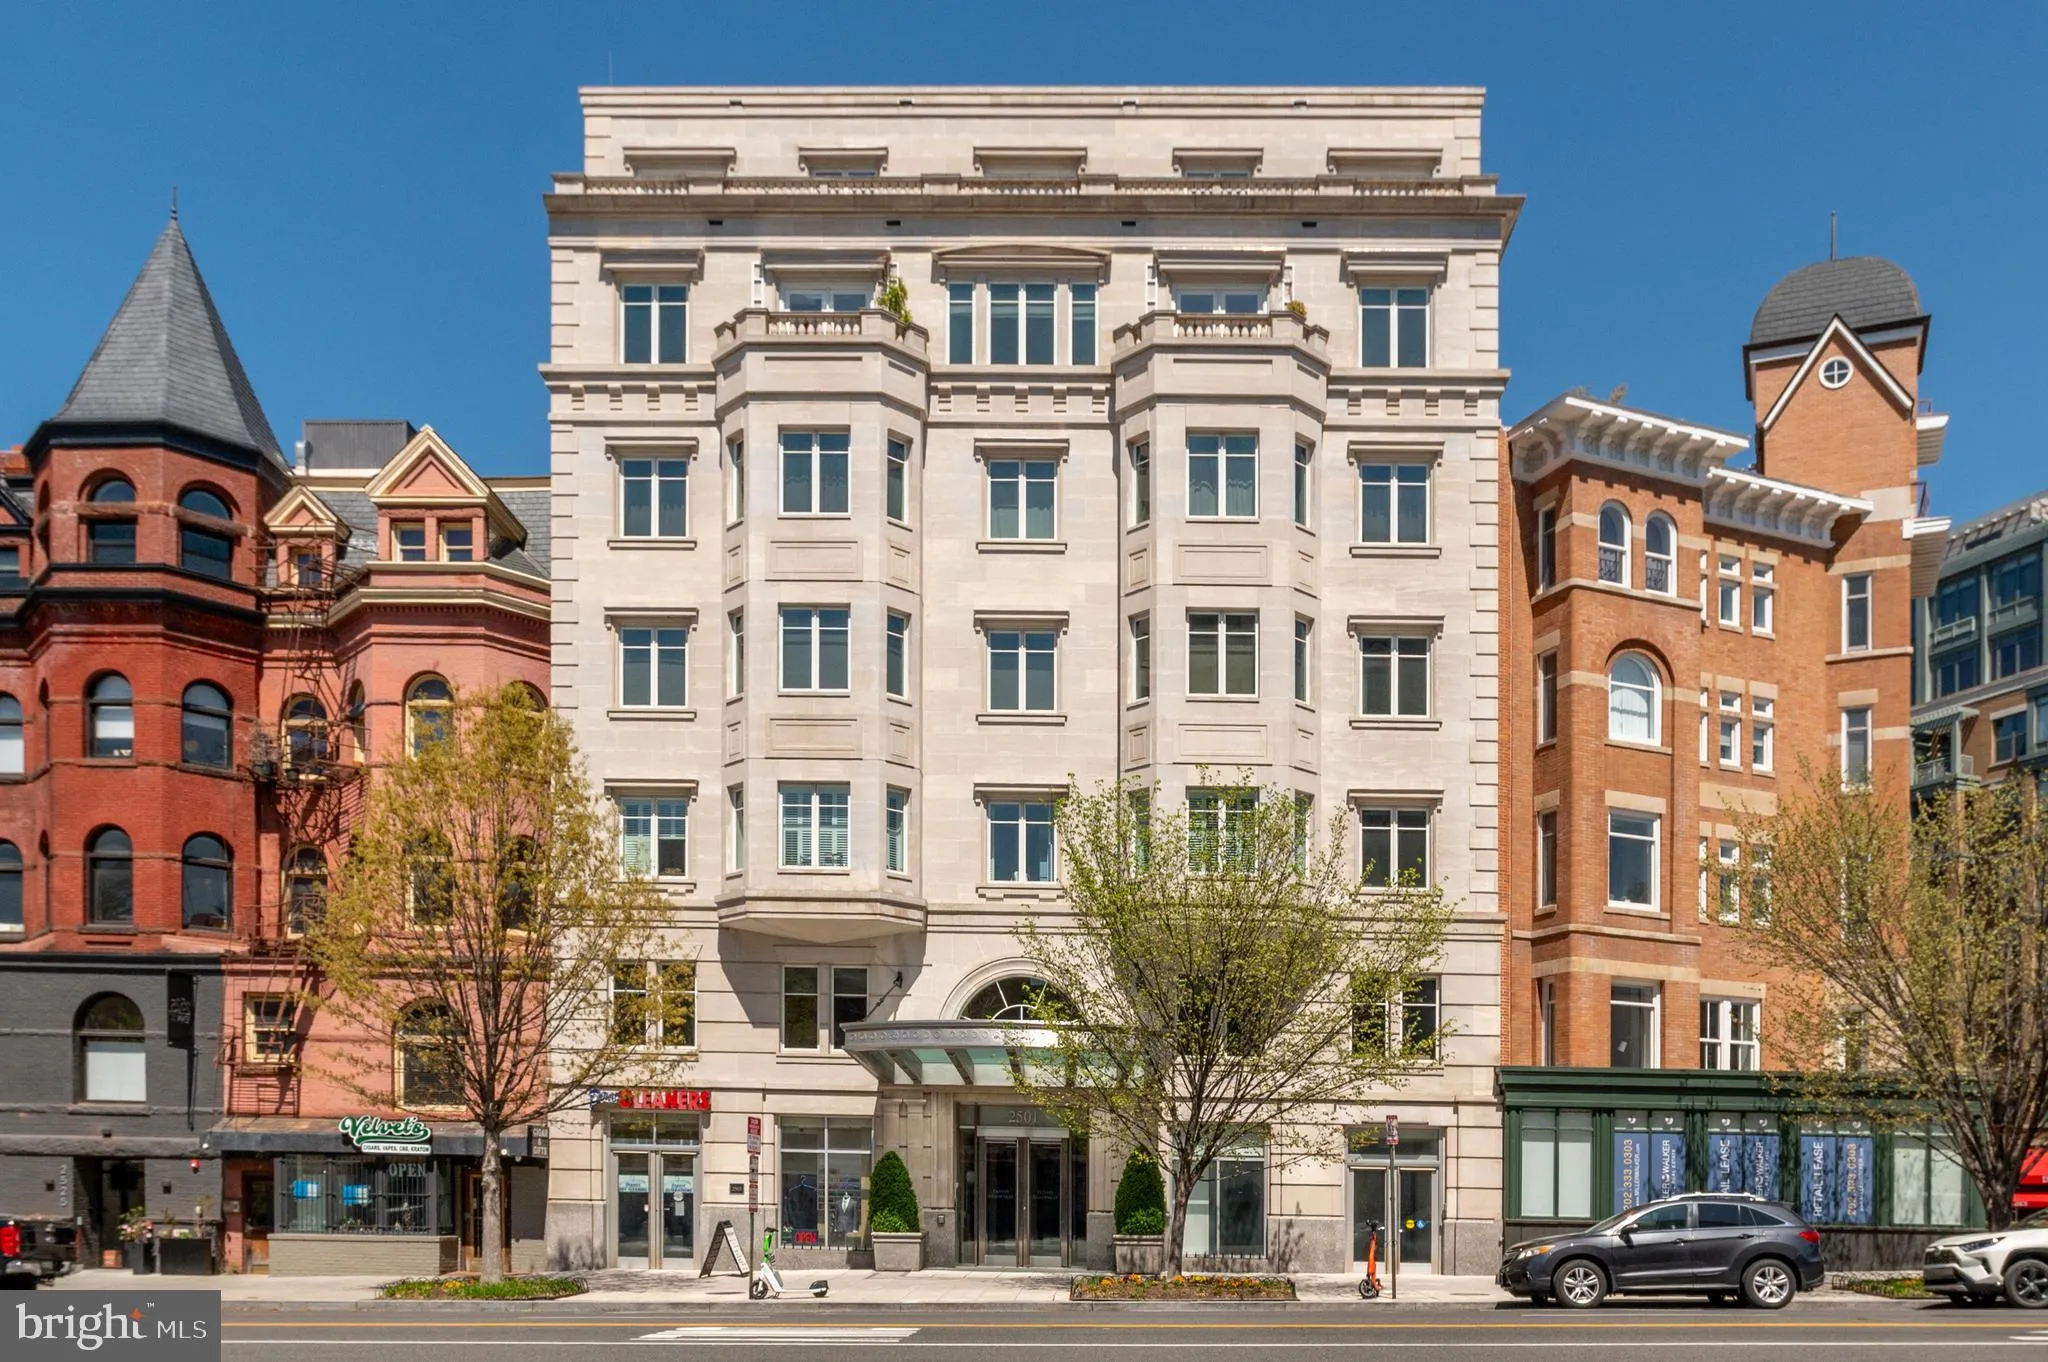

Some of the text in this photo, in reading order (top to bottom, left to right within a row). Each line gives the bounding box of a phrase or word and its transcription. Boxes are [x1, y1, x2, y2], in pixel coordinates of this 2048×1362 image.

[619, 1088, 710, 1110] CLEANERS
[339, 1114, 431, 1146] Velvet's
[1008, 1110, 1038, 1123] 2501
[388, 1163, 427, 1177] OPEN
[1662, 1139, 1671, 1174] WALKER
[1720, 1139, 1730, 1174] LEASE
[1813, 1141, 1824, 1176] LEASE
[794, 1231, 817, 1245] OPEN
